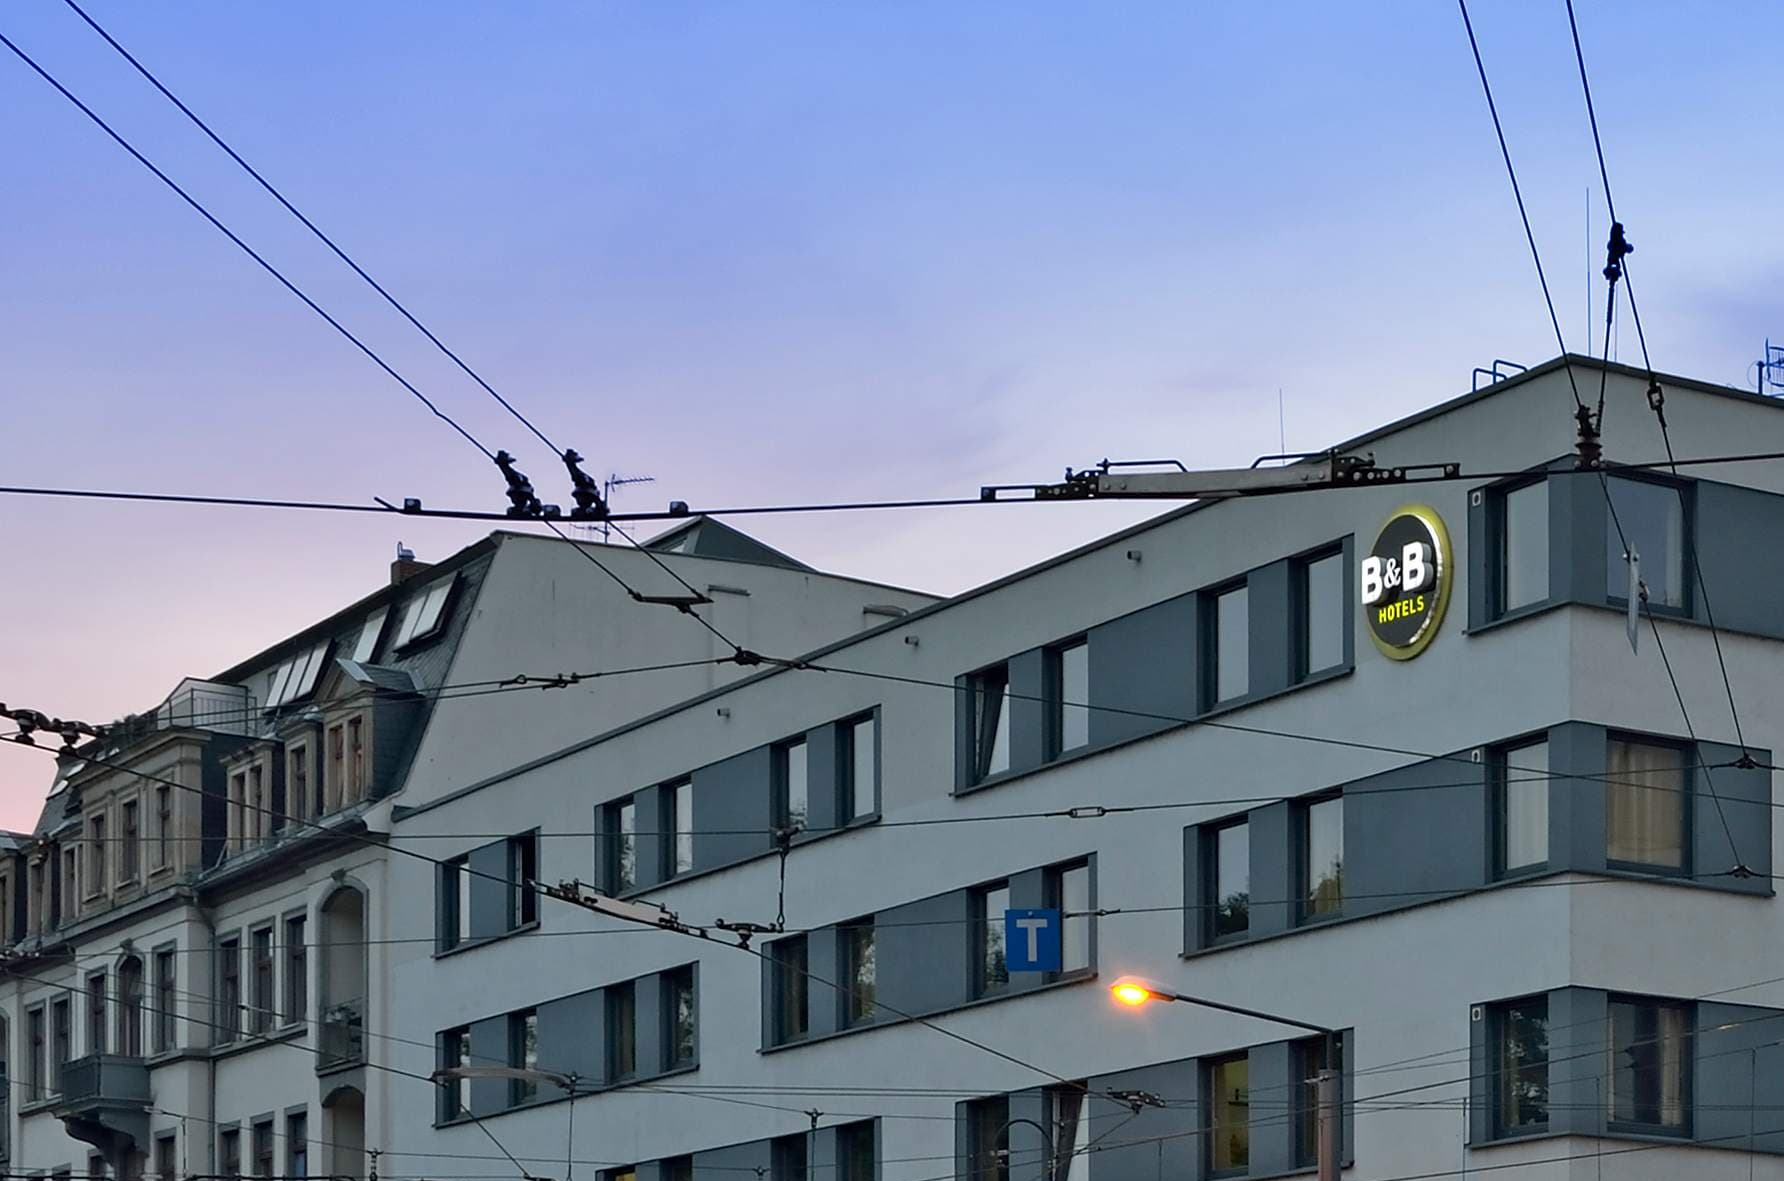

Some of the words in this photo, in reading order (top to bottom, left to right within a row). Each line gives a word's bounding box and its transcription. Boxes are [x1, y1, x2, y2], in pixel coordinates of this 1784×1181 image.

[1361, 541, 1430, 605] B&B
[1379, 595, 1425, 624] HOTELS
[1016, 919, 1048, 962] T
